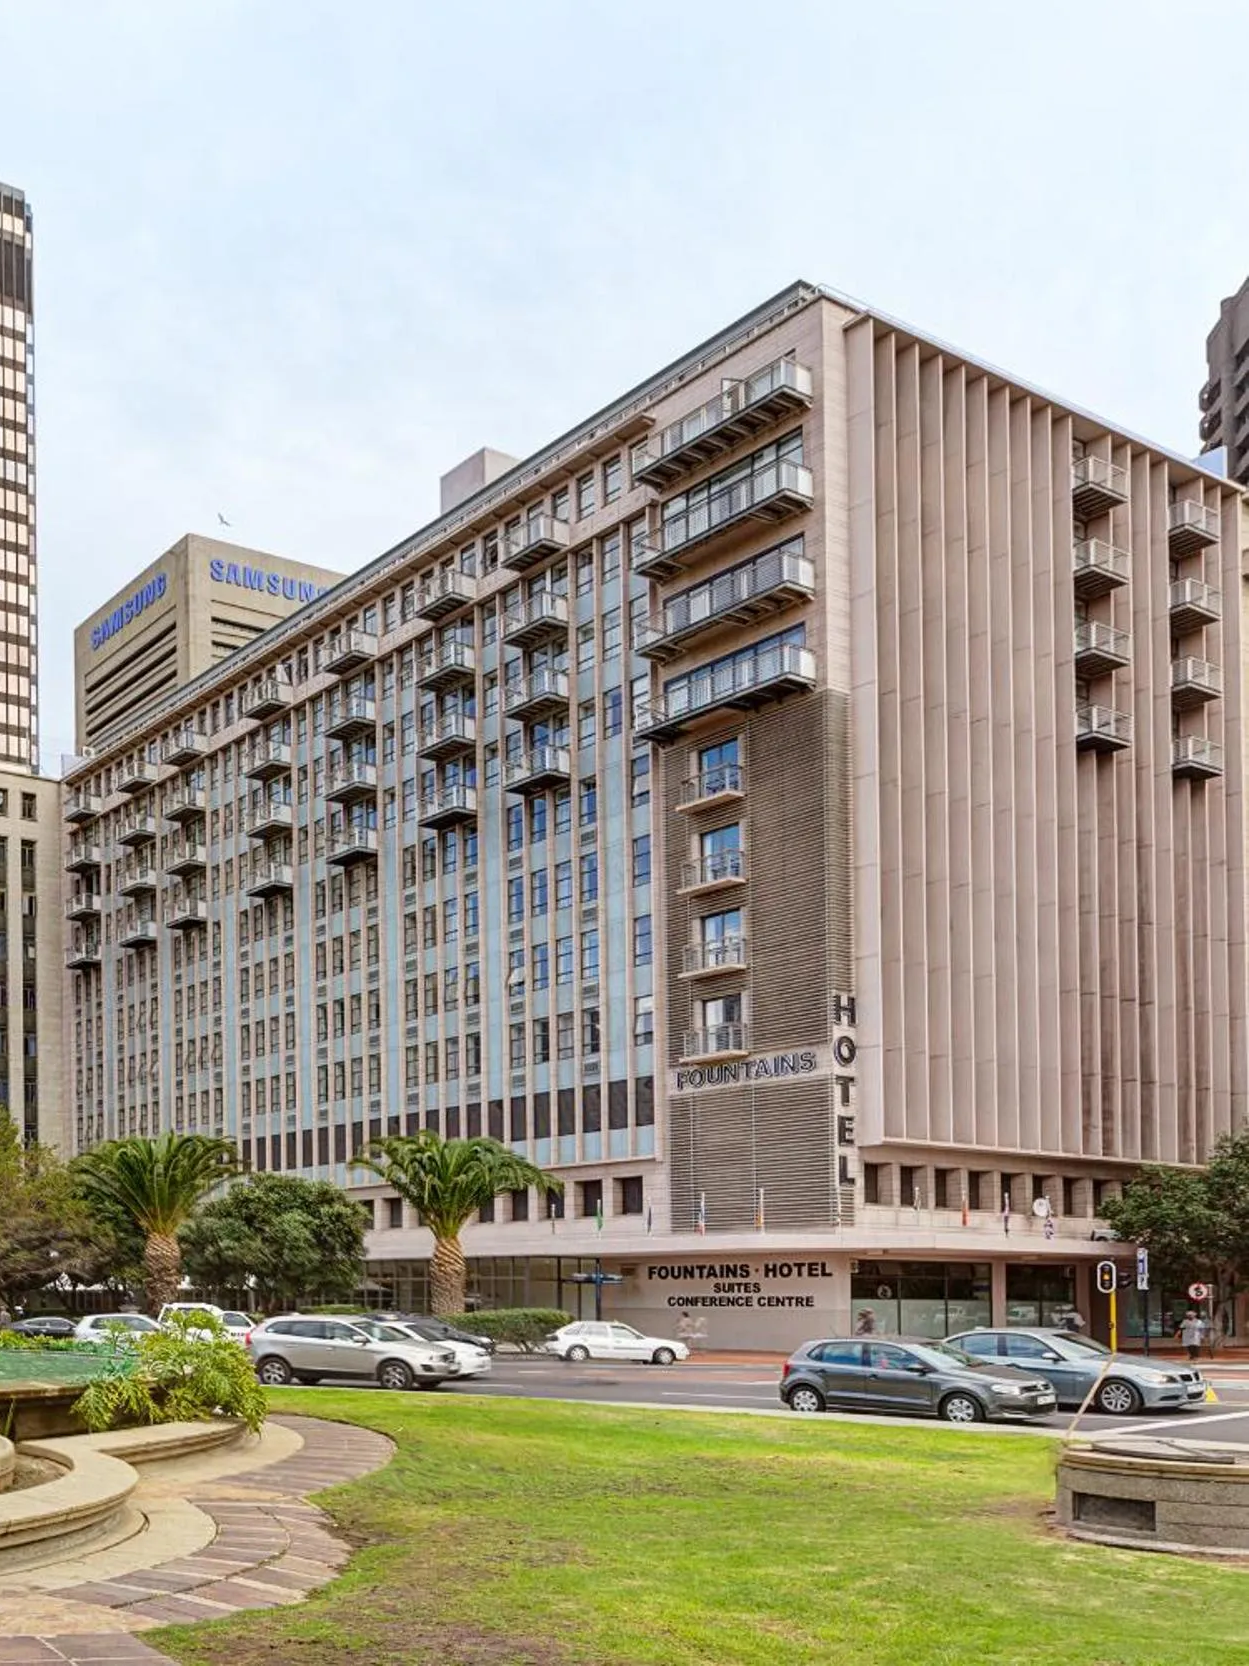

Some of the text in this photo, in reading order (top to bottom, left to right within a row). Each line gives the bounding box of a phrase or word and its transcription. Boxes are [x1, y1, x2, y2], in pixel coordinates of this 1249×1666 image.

[90, 572, 168, 650] SAMSUNG
[676, 1052, 817, 1091] FOUNTAINS
[833, 994, 857, 1186] HOTEL
[647, 1261, 834, 1280] FOUNTAINS HOTEL
[667, 1296, 815, 1307] CONFERENCE CENTRE
[713, 1282, 762, 1294] SUITES
